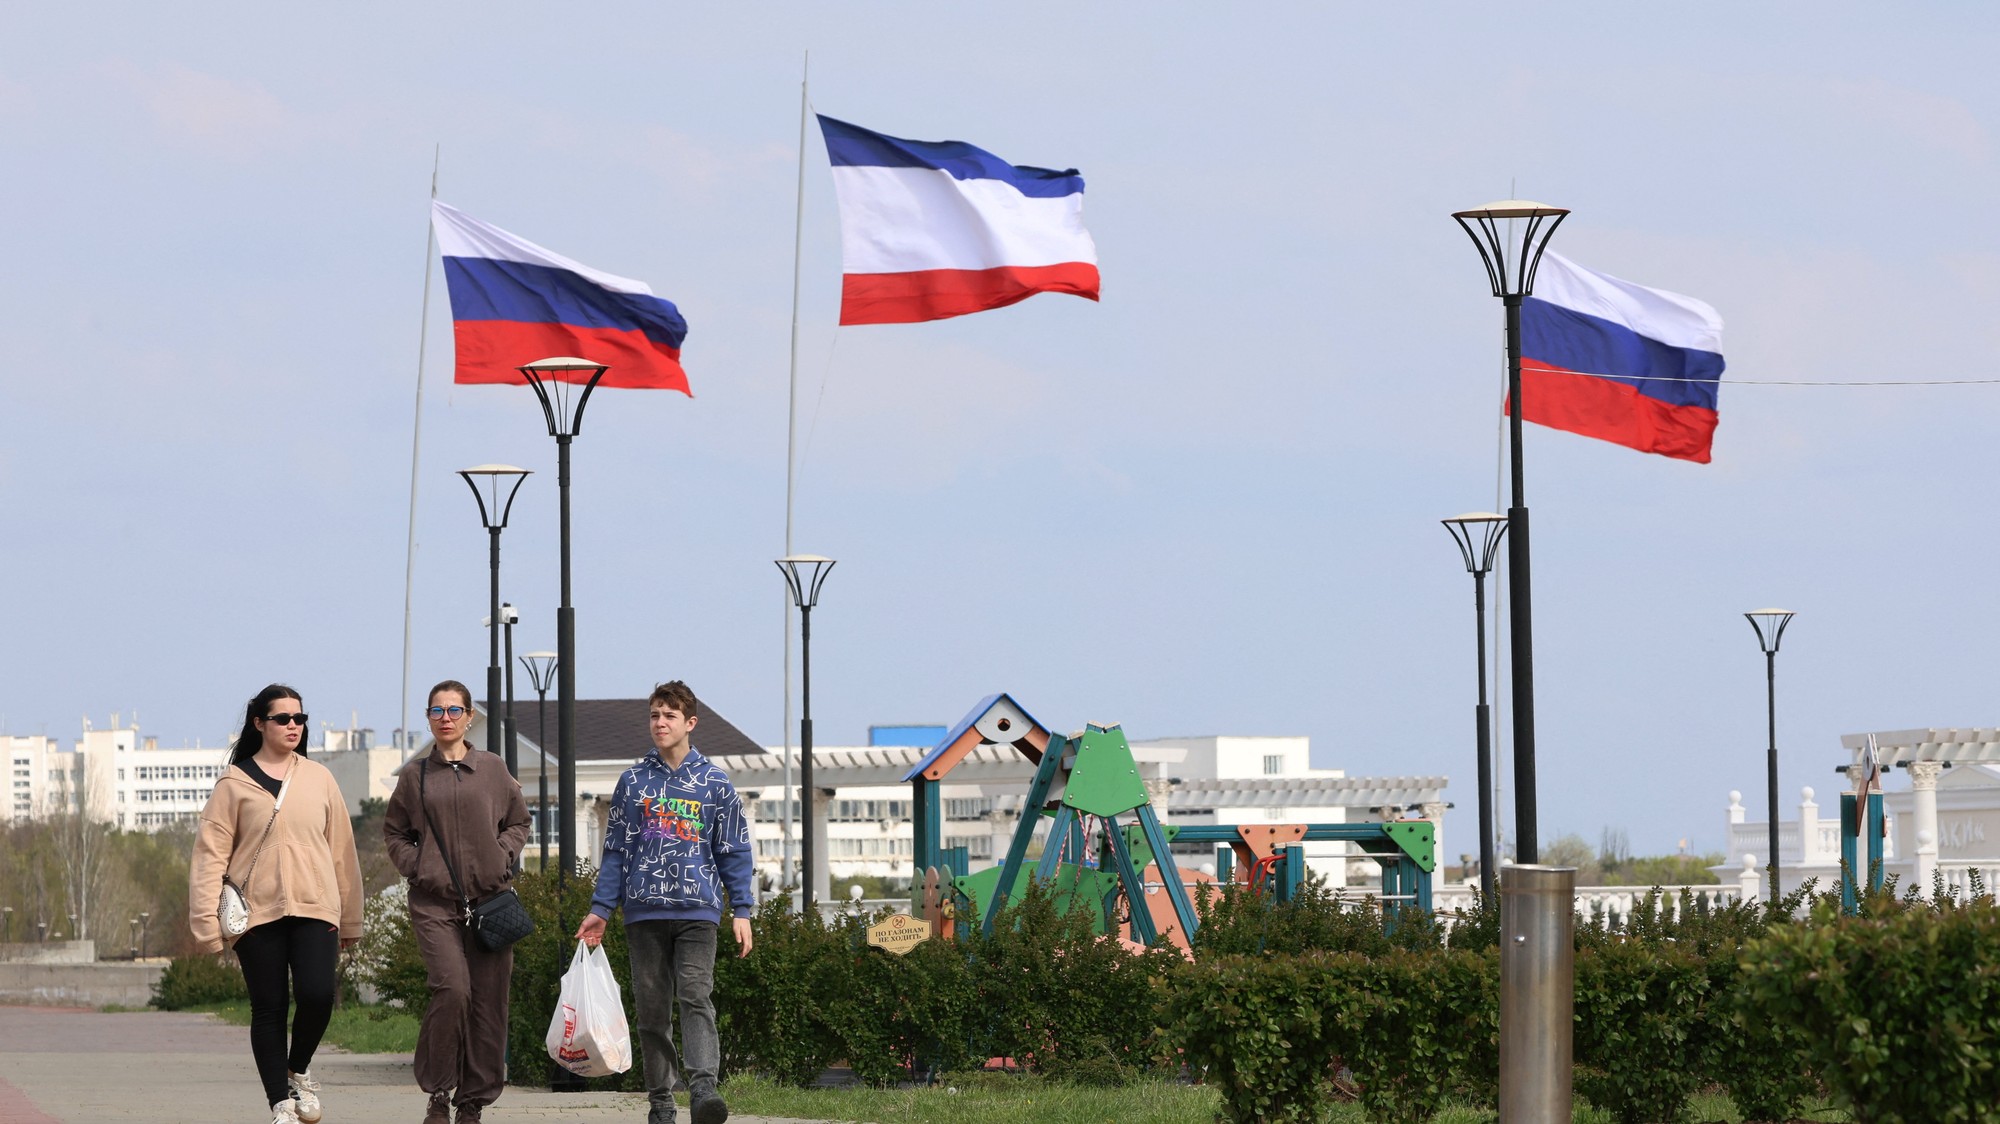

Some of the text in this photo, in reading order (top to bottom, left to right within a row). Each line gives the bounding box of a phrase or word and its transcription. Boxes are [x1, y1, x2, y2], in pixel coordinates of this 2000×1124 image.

[643, 798, 702, 820] I LIKE
[888, 927, 925, 937] ГАЗОНАМ
[890, 933, 922, 942] ХОДИТЬ
